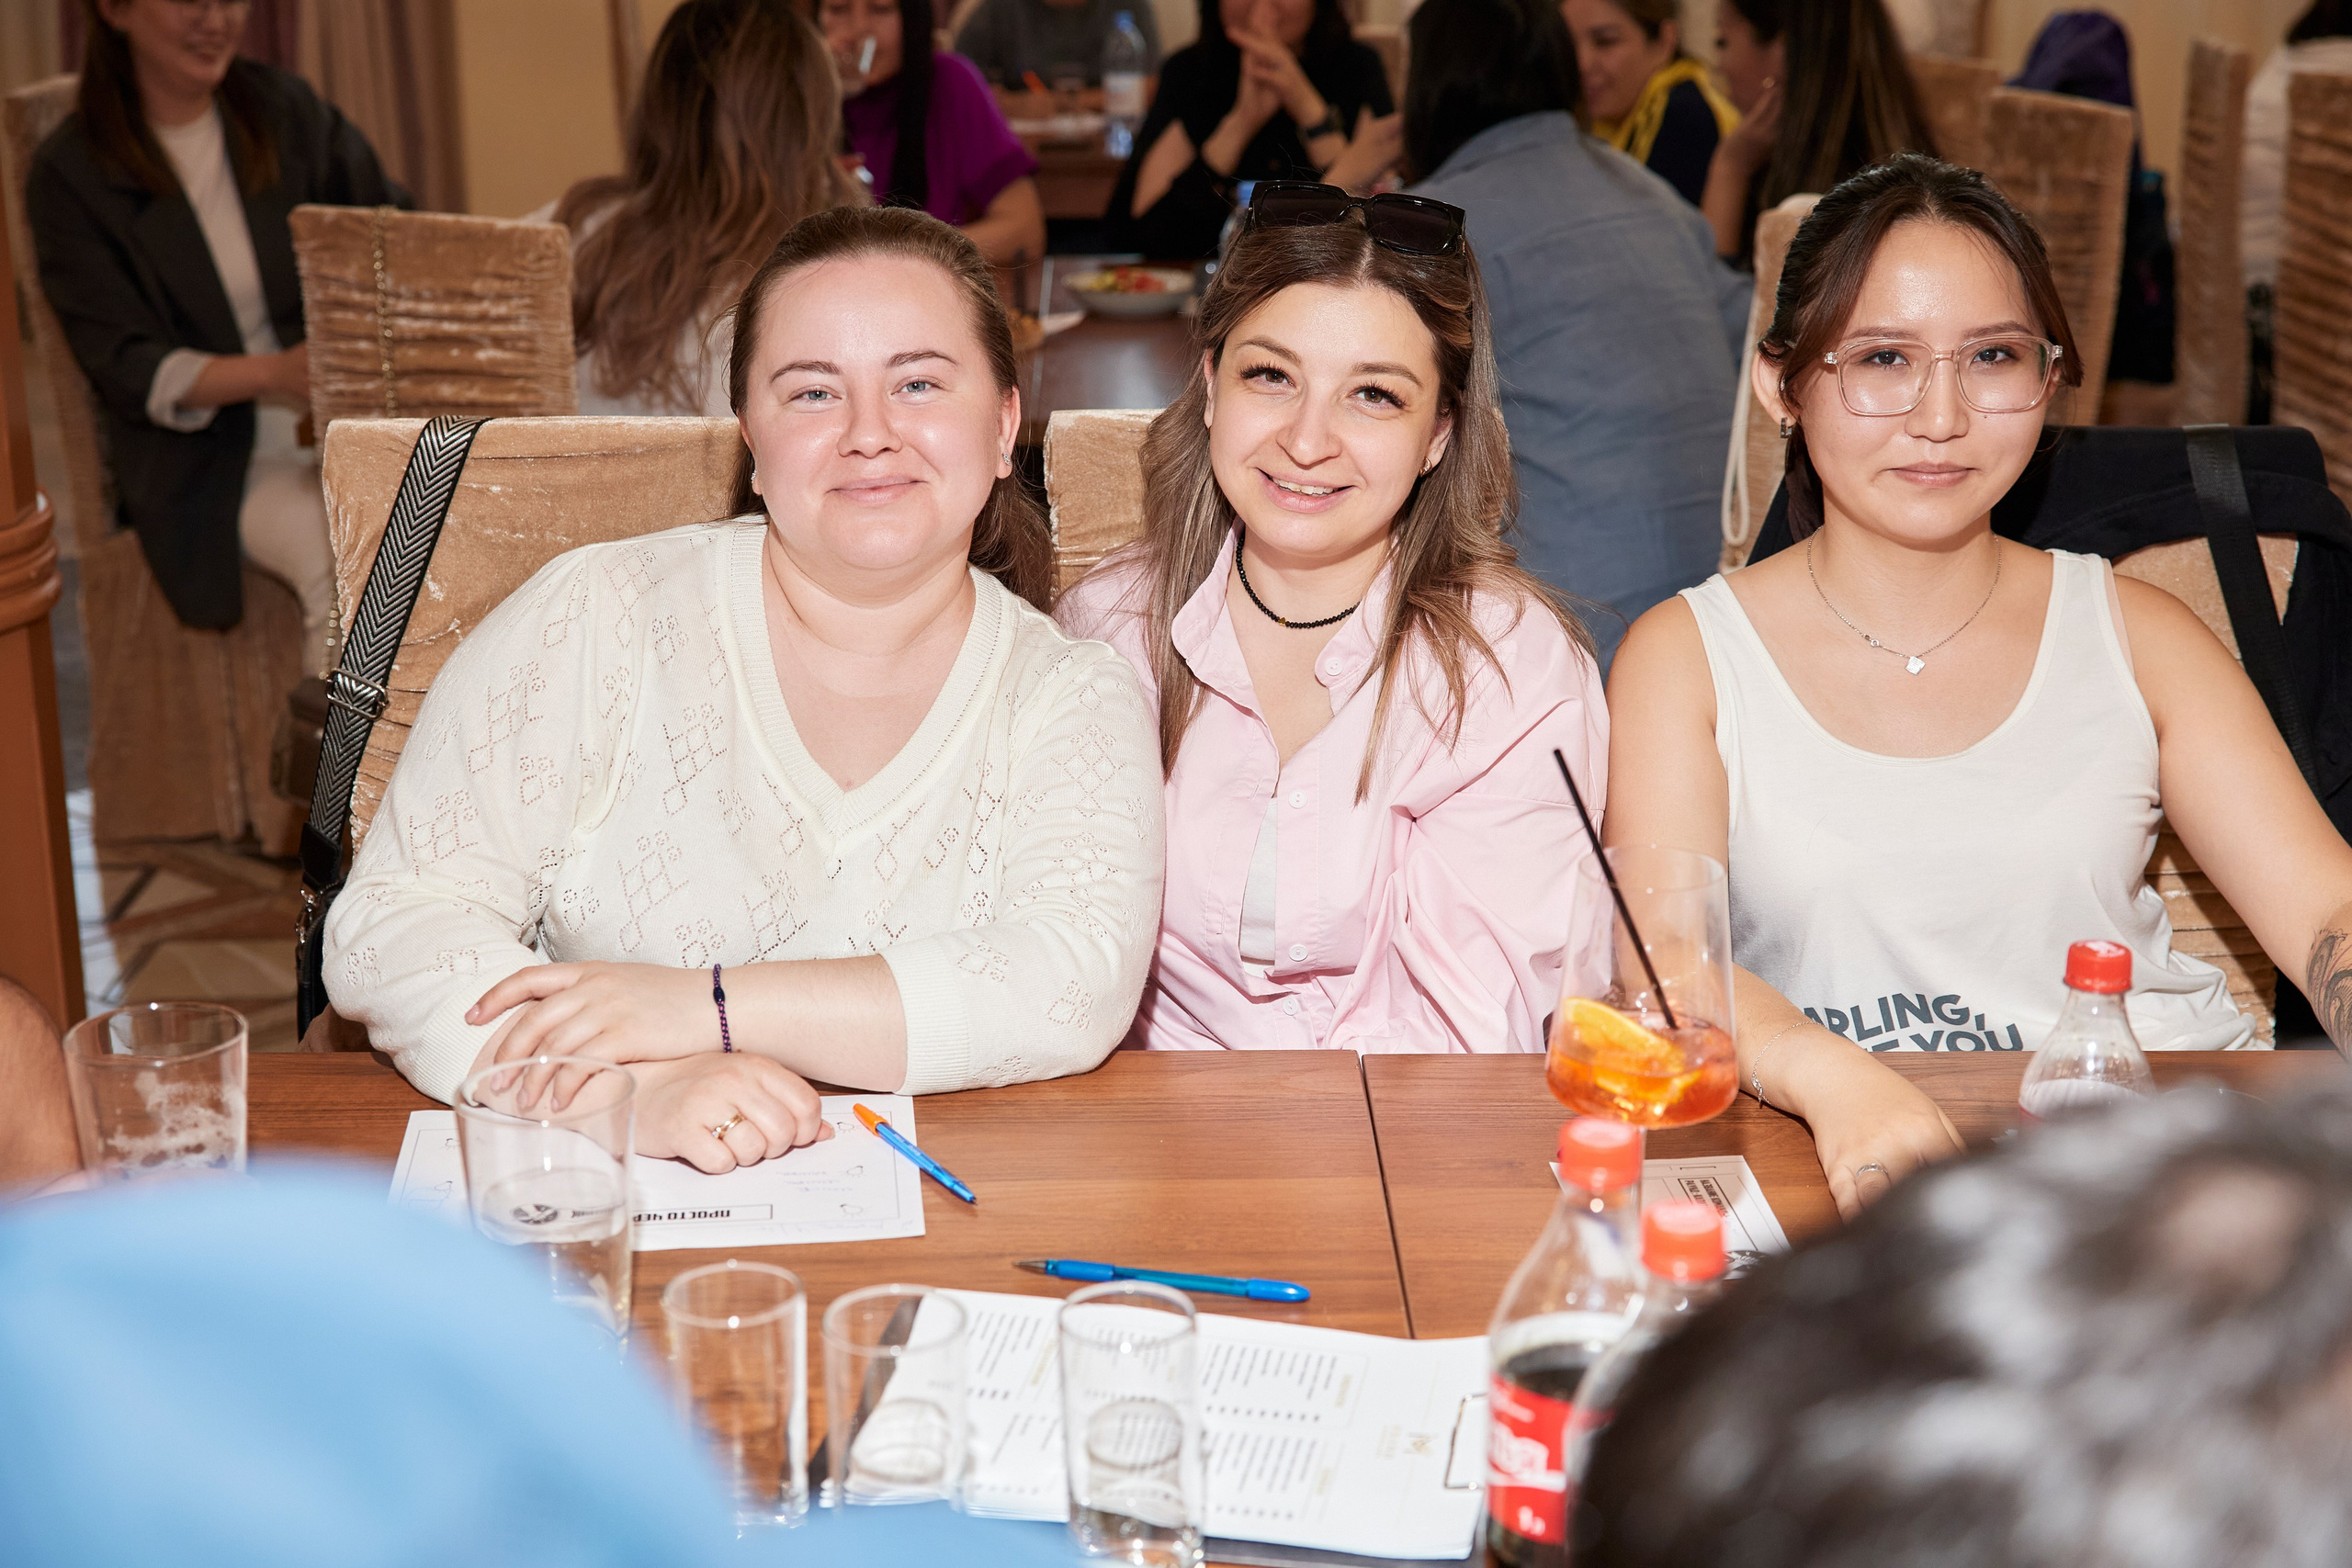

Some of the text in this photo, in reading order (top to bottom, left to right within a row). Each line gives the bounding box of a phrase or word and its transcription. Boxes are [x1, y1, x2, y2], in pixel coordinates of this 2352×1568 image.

[1804, 993, 1985, 1042] ARLING,
[1909, 1023, 2024, 1052] YOU
[632, 1210, 731, 1224] ПРОСТО ЧЕР
